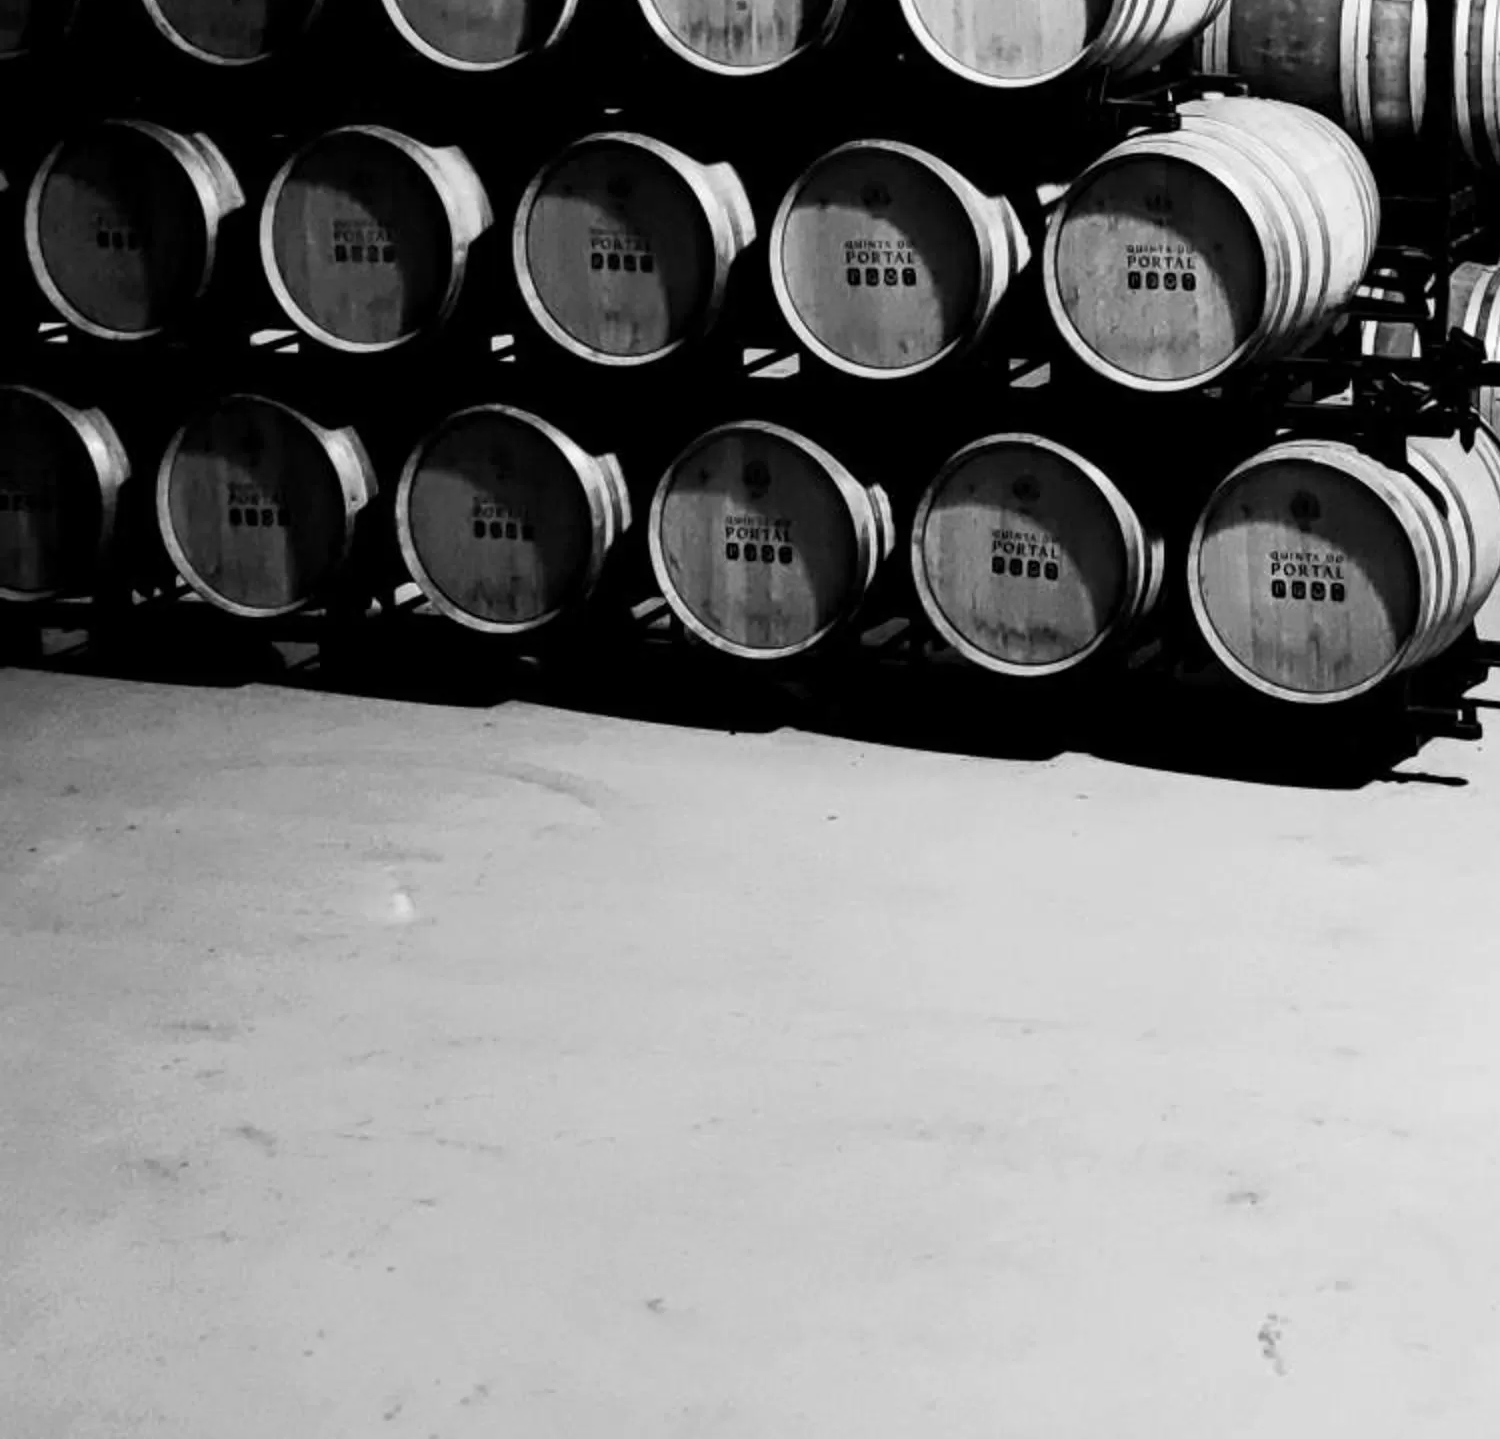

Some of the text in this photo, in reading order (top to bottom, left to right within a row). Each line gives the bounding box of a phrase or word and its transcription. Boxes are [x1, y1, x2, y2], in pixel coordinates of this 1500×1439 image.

[844, 240, 891, 250] QUINTA
[1126, 244, 1172, 254] QUINTA
[845, 251, 914, 264] PORTAL
[1126, 255, 1196, 270] PORTAL
[725, 526, 791, 542] PORTAL
[992, 540, 1058, 559] PORTAL
[1269, 550, 1320, 562] QUINTA
[1271, 563, 1345, 579] PORTAL
